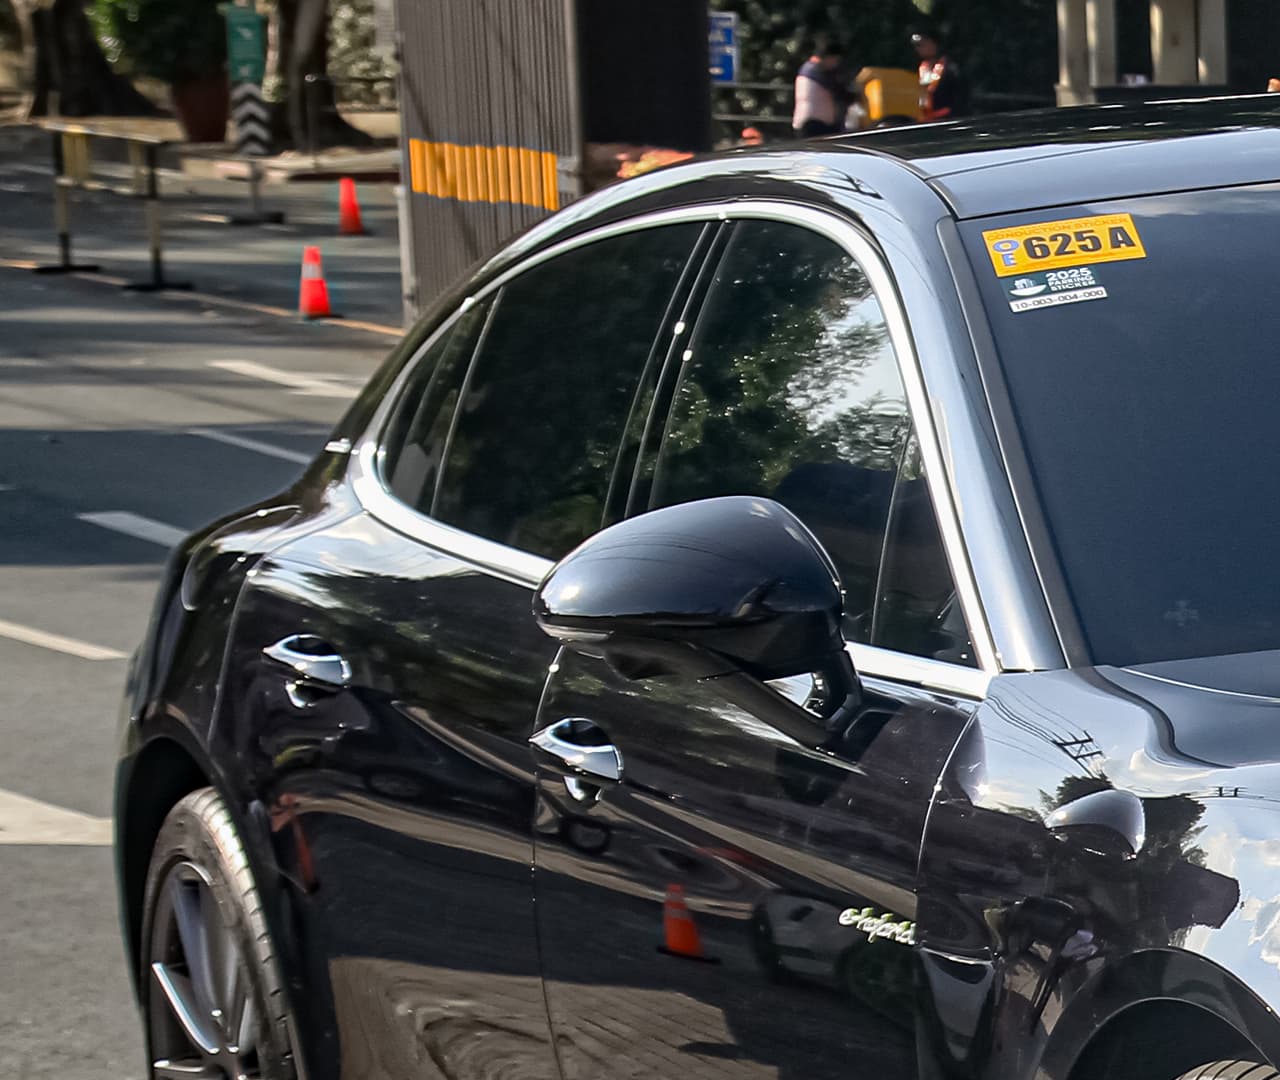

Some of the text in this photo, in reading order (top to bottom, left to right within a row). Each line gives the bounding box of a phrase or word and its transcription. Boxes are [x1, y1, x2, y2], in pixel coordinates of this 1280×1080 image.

[1075, 217, 1129, 230] STICKER
[1023, 226, 1136, 259] 625 A
[1045, 267, 1092, 280] 2025
[1048, 275, 1094, 287] PARKING
[1050, 280, 1096, 292] STICKER
